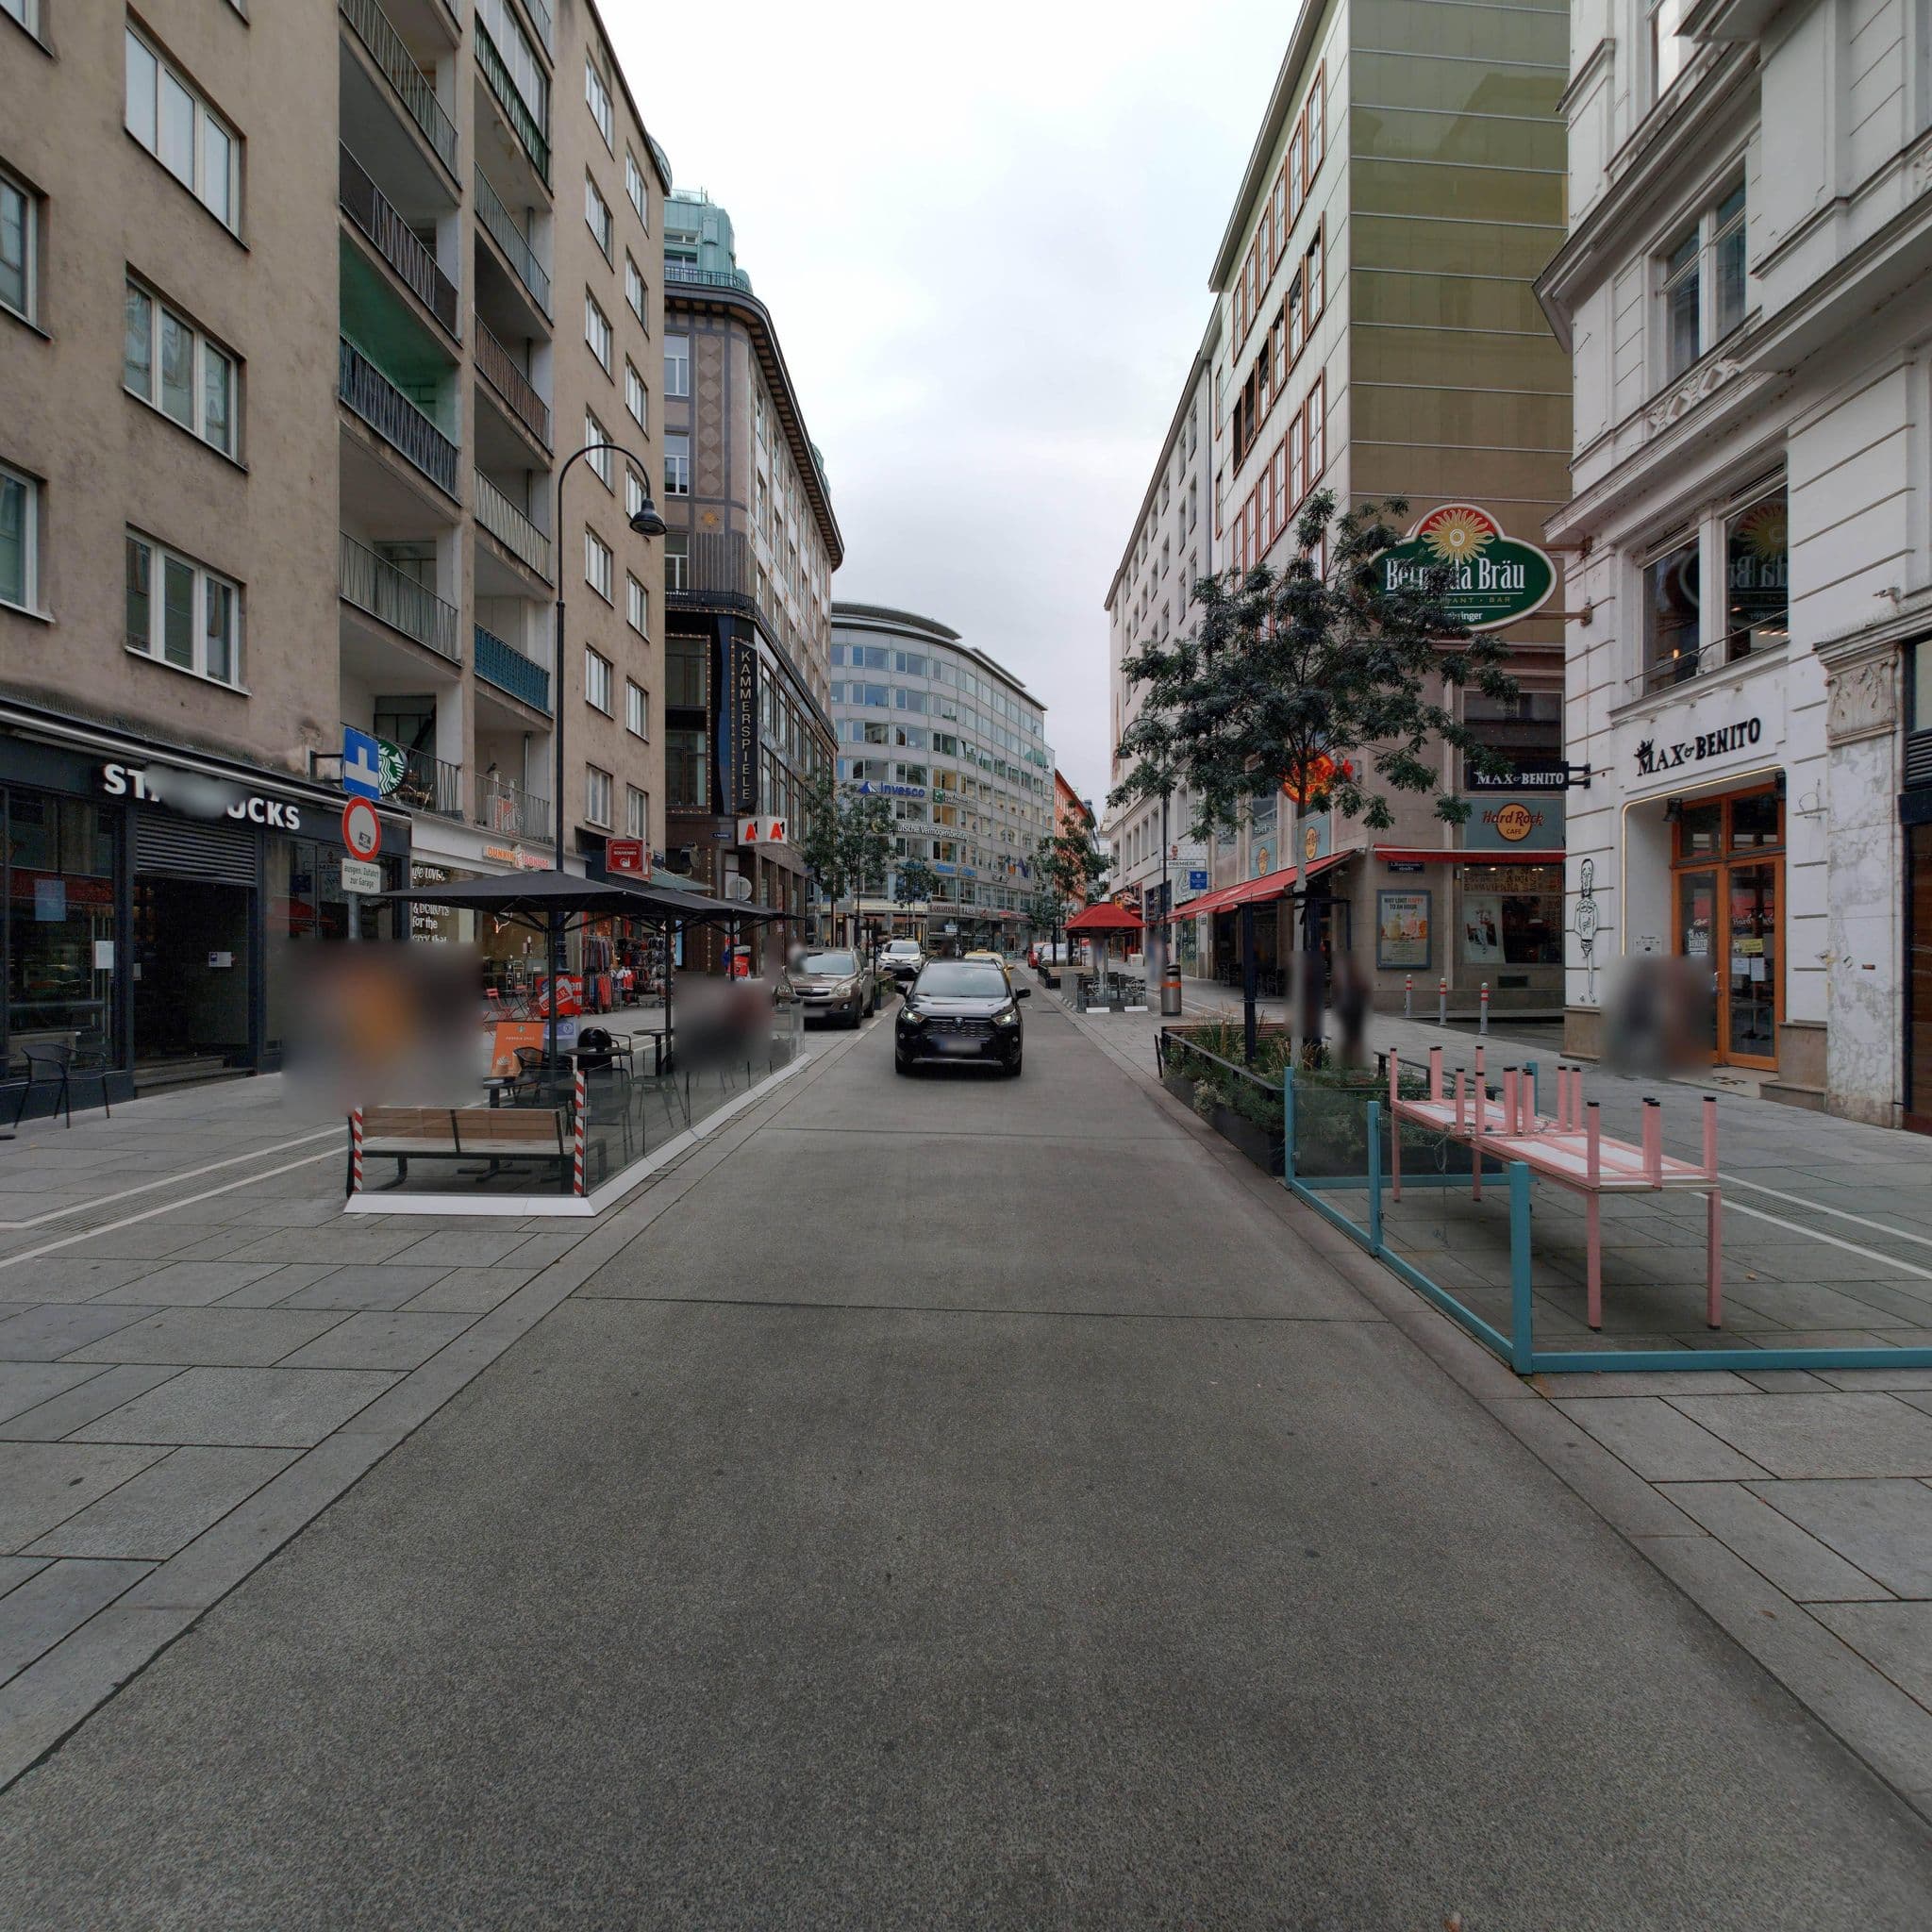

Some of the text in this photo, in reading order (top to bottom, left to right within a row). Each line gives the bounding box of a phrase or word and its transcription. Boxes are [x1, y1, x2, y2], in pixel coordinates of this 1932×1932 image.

[1477, 558, 1525, 590] Bräu
[740, 650, 752, 800] KAMMERSPIELE
[1637, 742, 1686, 776] MAX
[1694, 717, 1761, 760] BENITO
[1476, 774, 1514, 785] MAX
[1521, 773, 1564, 785] BENITO
[104, 763, 301, 830] STUCKS
[744, 821, 758, 841] A1
[770, 821, 785, 841] A1
[1482, 810, 1544, 826] Hard Rock
